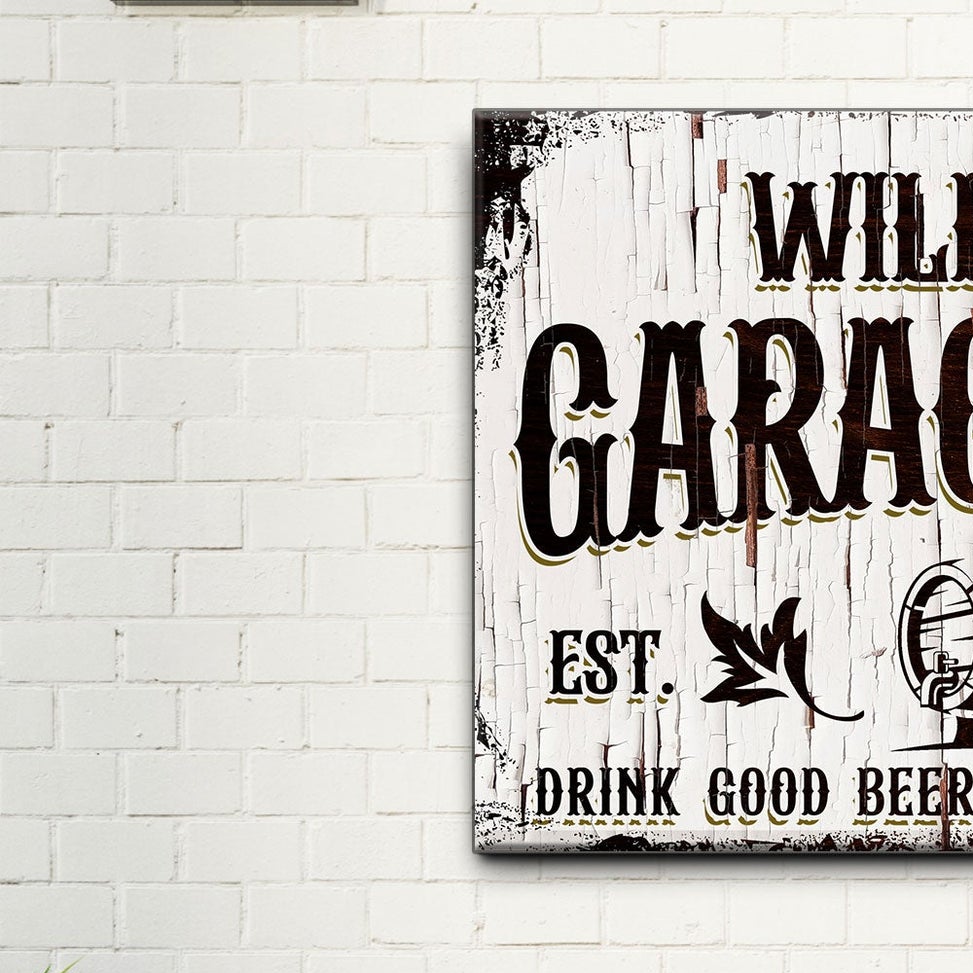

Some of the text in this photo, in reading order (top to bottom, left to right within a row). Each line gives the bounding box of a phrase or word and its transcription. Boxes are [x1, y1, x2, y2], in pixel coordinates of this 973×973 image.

[547, 629, 675, 698] EST.
[534, 766, 681, 821] DRINK
[706, 766, 830, 821] GOOD
